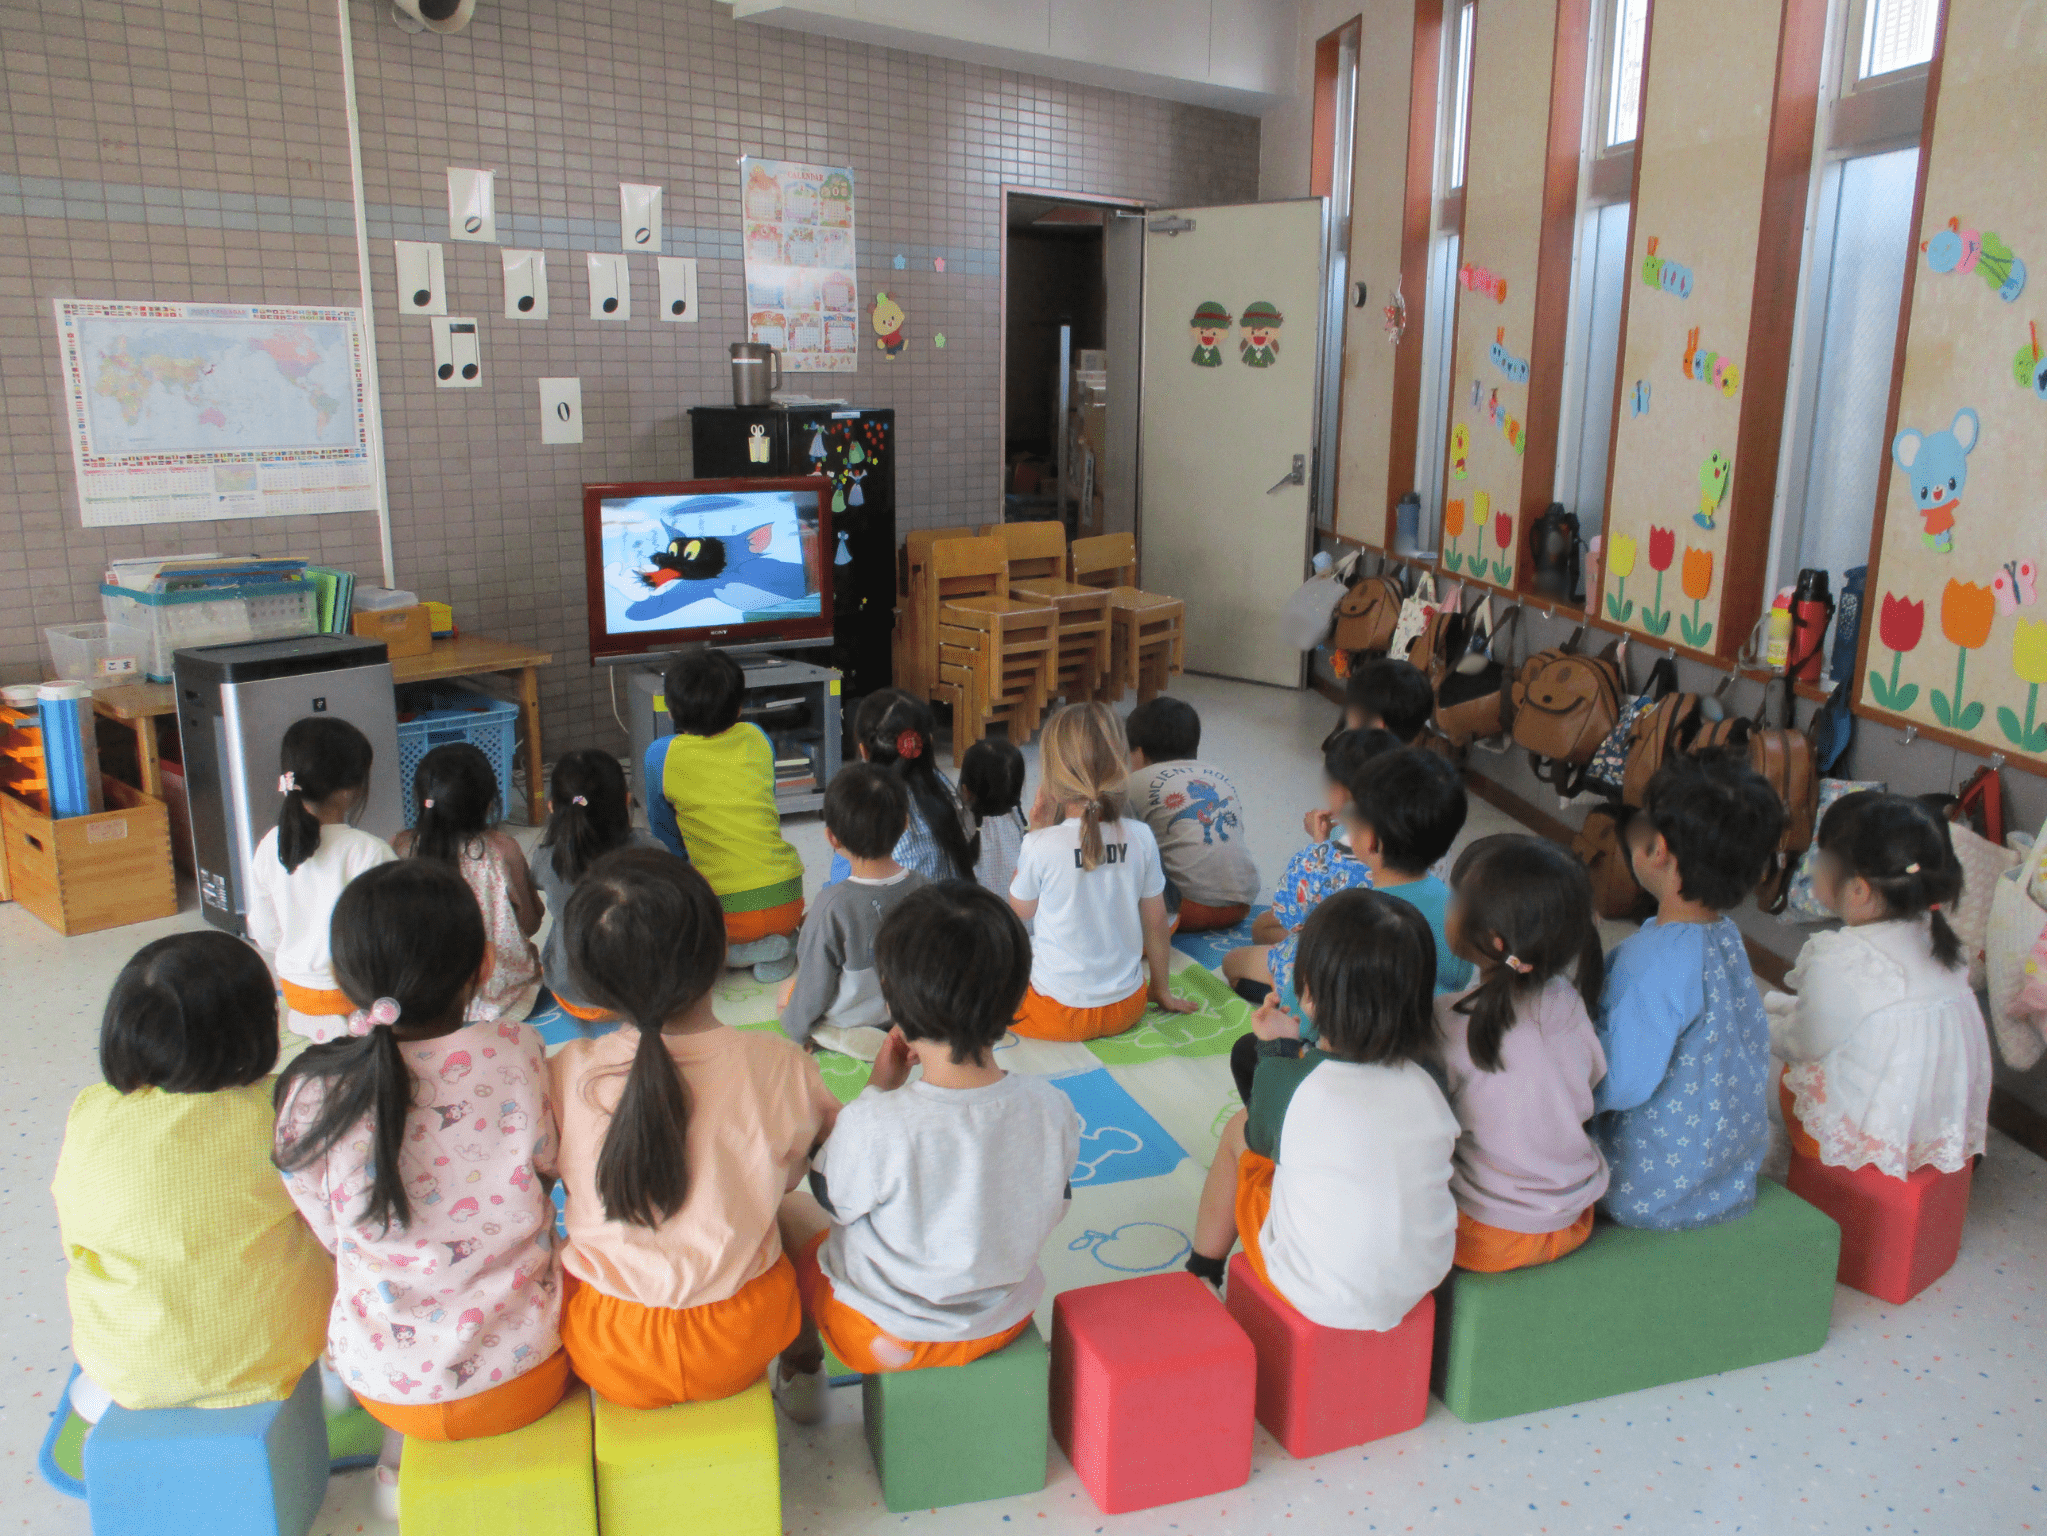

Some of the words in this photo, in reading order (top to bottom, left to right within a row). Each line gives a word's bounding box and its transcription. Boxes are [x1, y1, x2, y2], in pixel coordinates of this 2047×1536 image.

[787, 170, 825, 182] CALENDAR
[1148, 767, 1195, 806] ANCIENT
[1074, 843, 1128, 868] DDY
